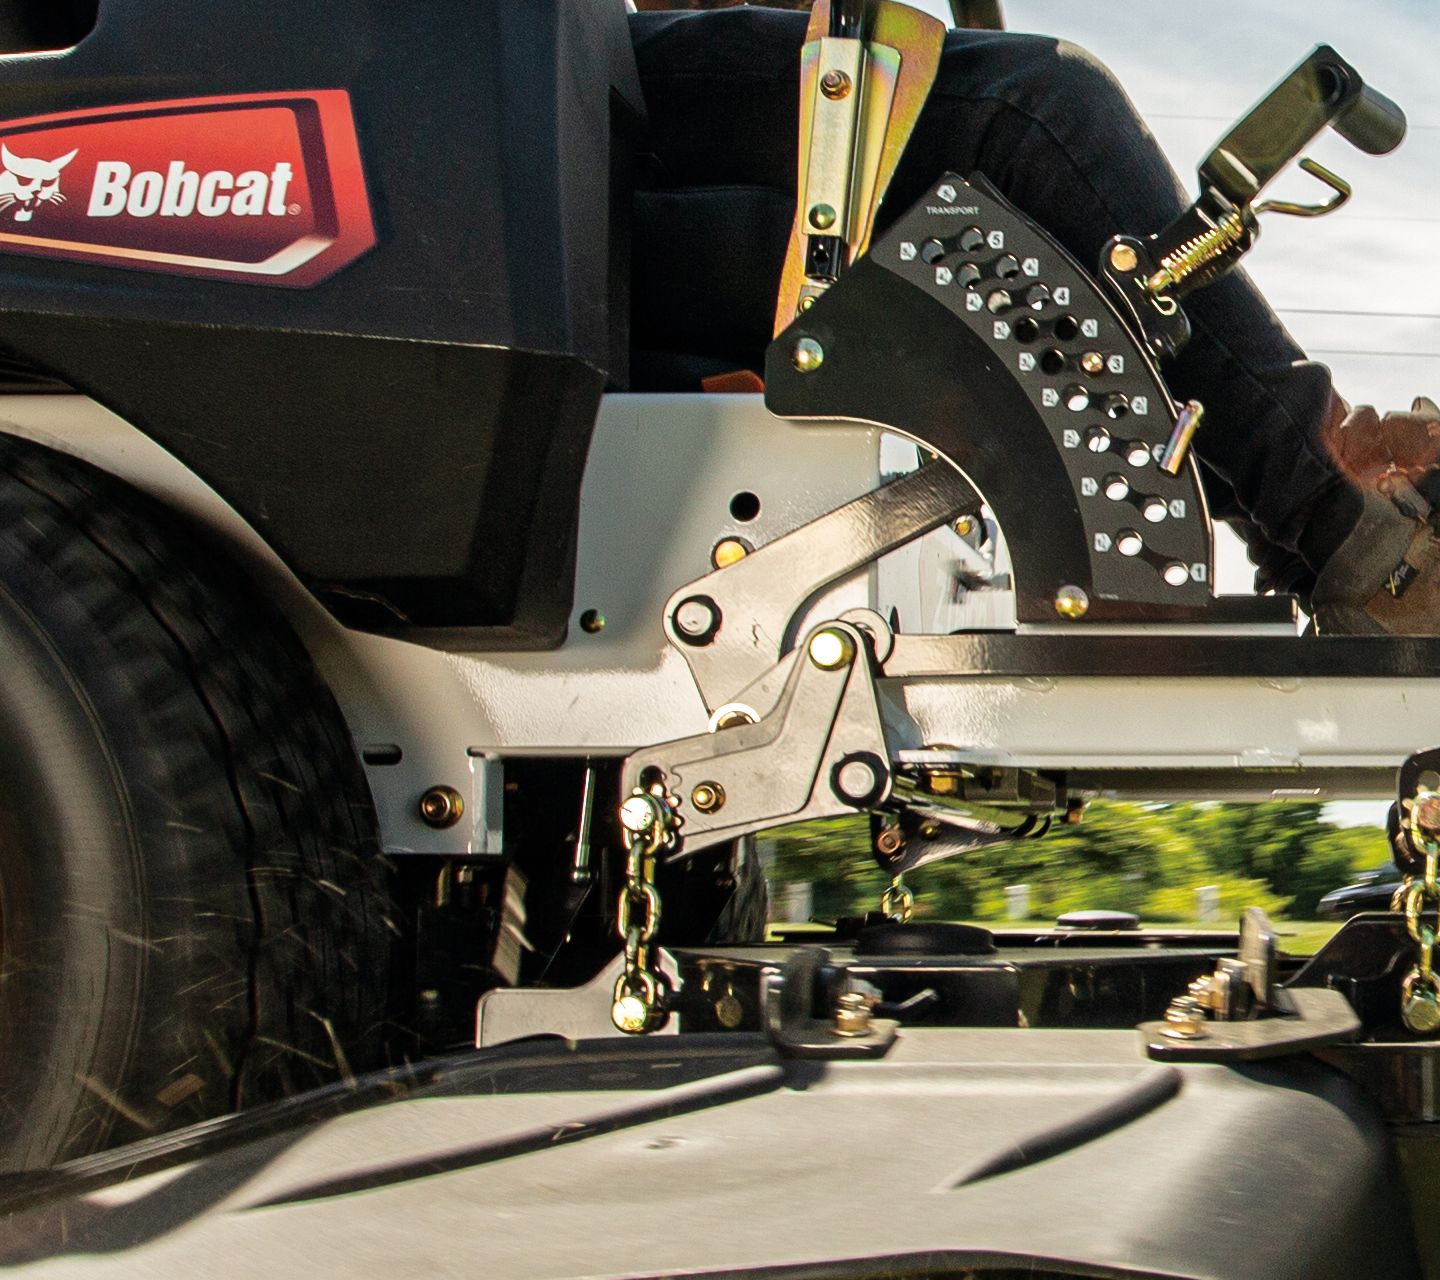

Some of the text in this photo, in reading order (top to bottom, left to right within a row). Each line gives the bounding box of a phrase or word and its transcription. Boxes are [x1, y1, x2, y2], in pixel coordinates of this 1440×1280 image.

[87, 160, 293, 218] Bobcat
[926, 206, 980, 216] TRANSPORT
[992, 233, 1001, 246] 5
[1058, 289, 1066, 302] 4
[1112, 357, 1121, 370] 3
